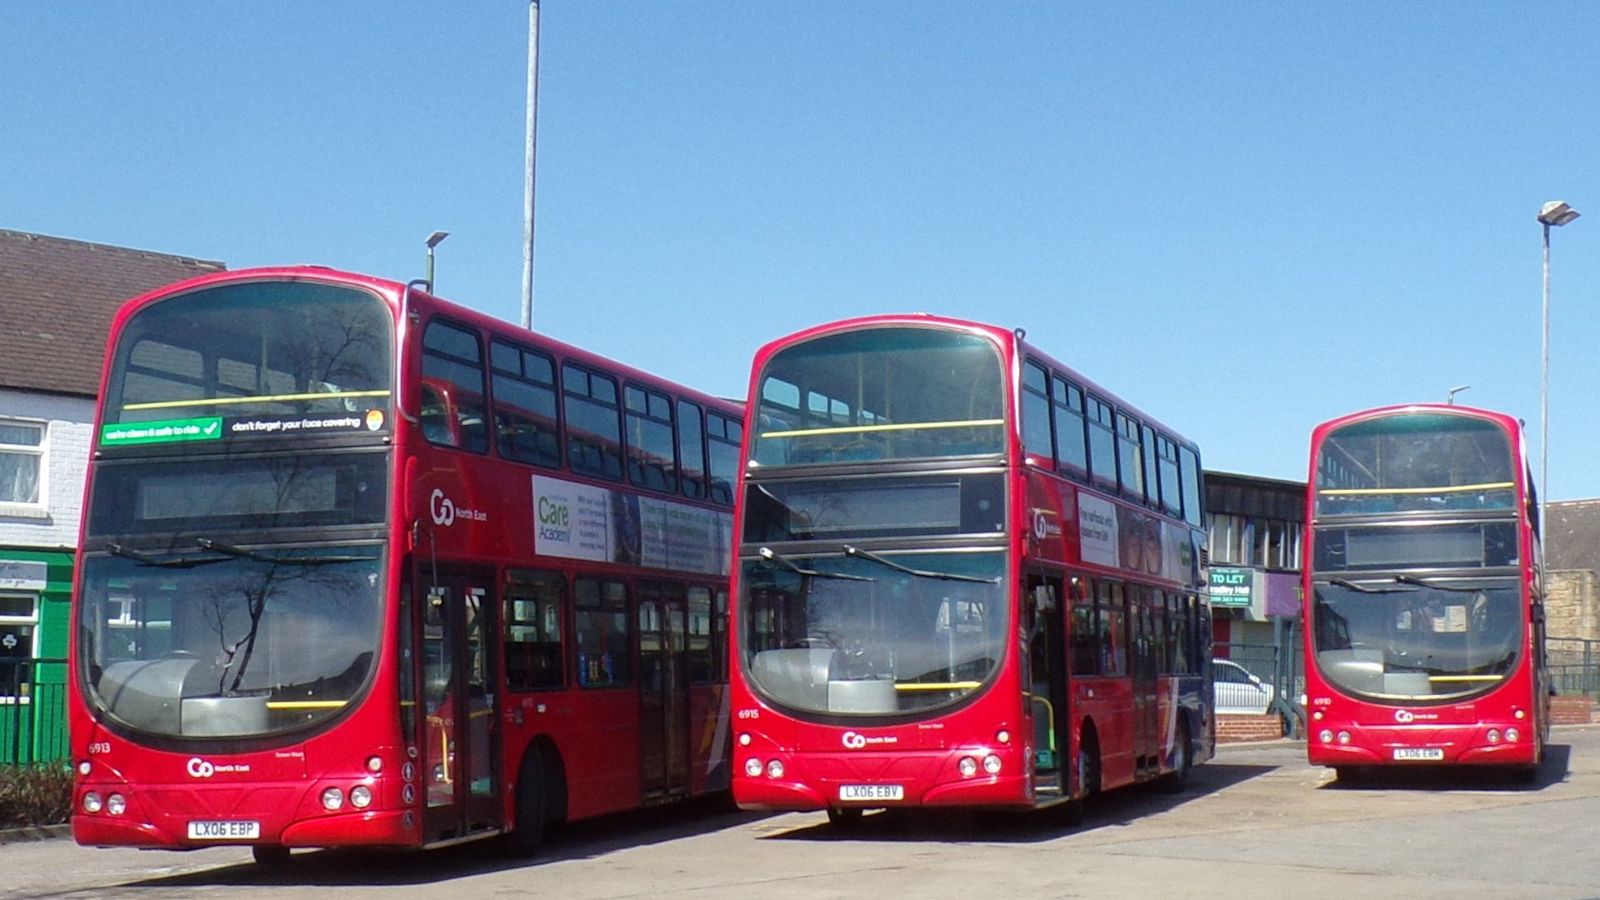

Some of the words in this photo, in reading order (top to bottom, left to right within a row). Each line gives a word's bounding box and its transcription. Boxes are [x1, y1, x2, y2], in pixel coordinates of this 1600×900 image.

[232, 421, 255, 432] don't
[255, 420, 281, 433] forget
[282, 420, 301, 431] your
[302, 418, 322, 429] face
[322, 417, 361, 429] covering
[455, 507, 474, 520] North
[474, 510, 488, 521] East
[539, 496, 569, 526] Care
[539, 527, 571, 544] Academy
[1212, 575, 1225, 584] TO
[1226, 575, 1245, 584] LET
[739, 709, 760, 719] 6915
[89, 742, 110, 754] 6913
[235, 764, 250, 772] East
[846, 786, 874, 798] LX06
[877, 786, 898, 798] EBV
[195, 822, 227, 836] LX06
[230, 822, 254, 836] EBP
